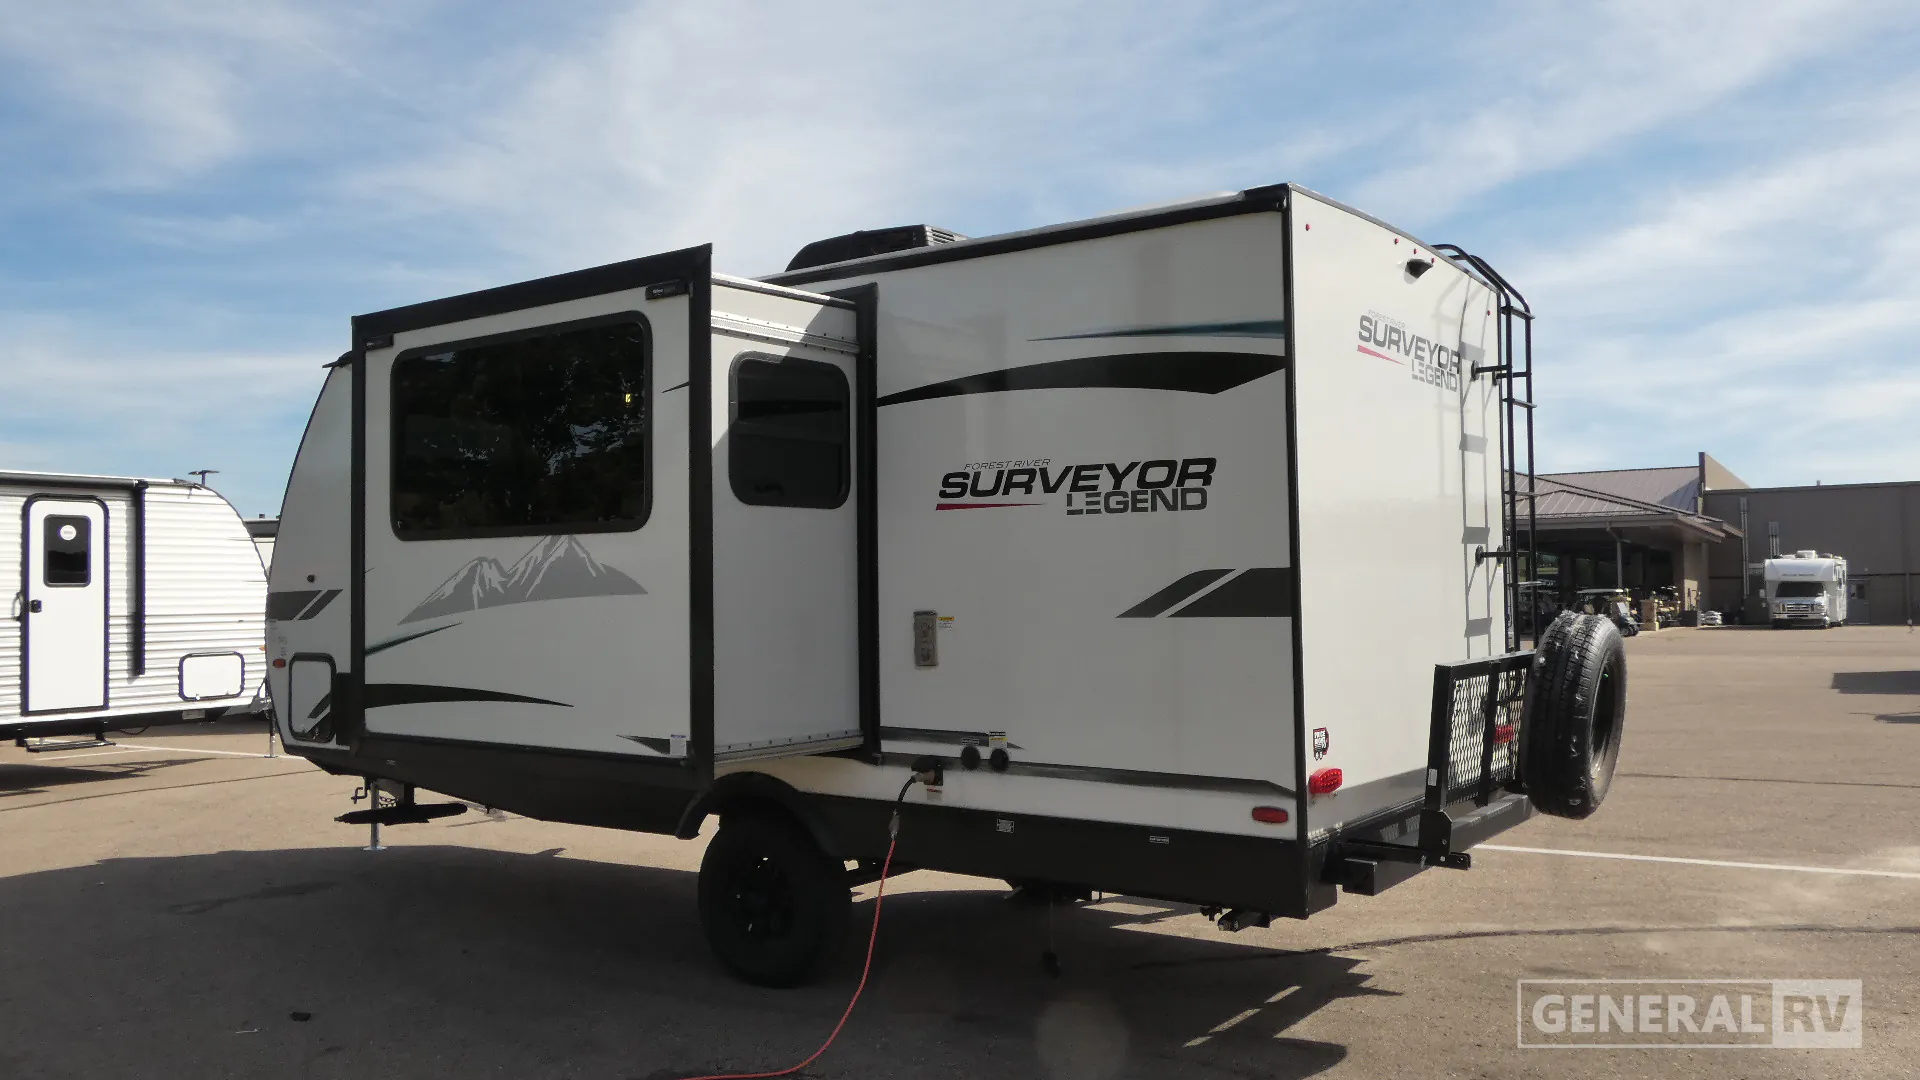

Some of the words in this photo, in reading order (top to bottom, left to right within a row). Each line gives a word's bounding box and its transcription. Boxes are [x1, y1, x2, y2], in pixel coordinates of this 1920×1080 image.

[1358, 314, 1461, 374] SURVEYOR
[1411, 359, 1458, 392] LEGEND
[938, 457, 1217, 498] SURVEYOR
[964, 460, 1013, 471] FOREST
[1013, 458, 1051, 468] RIVER
[1066, 487, 1208, 515] LEGEND
